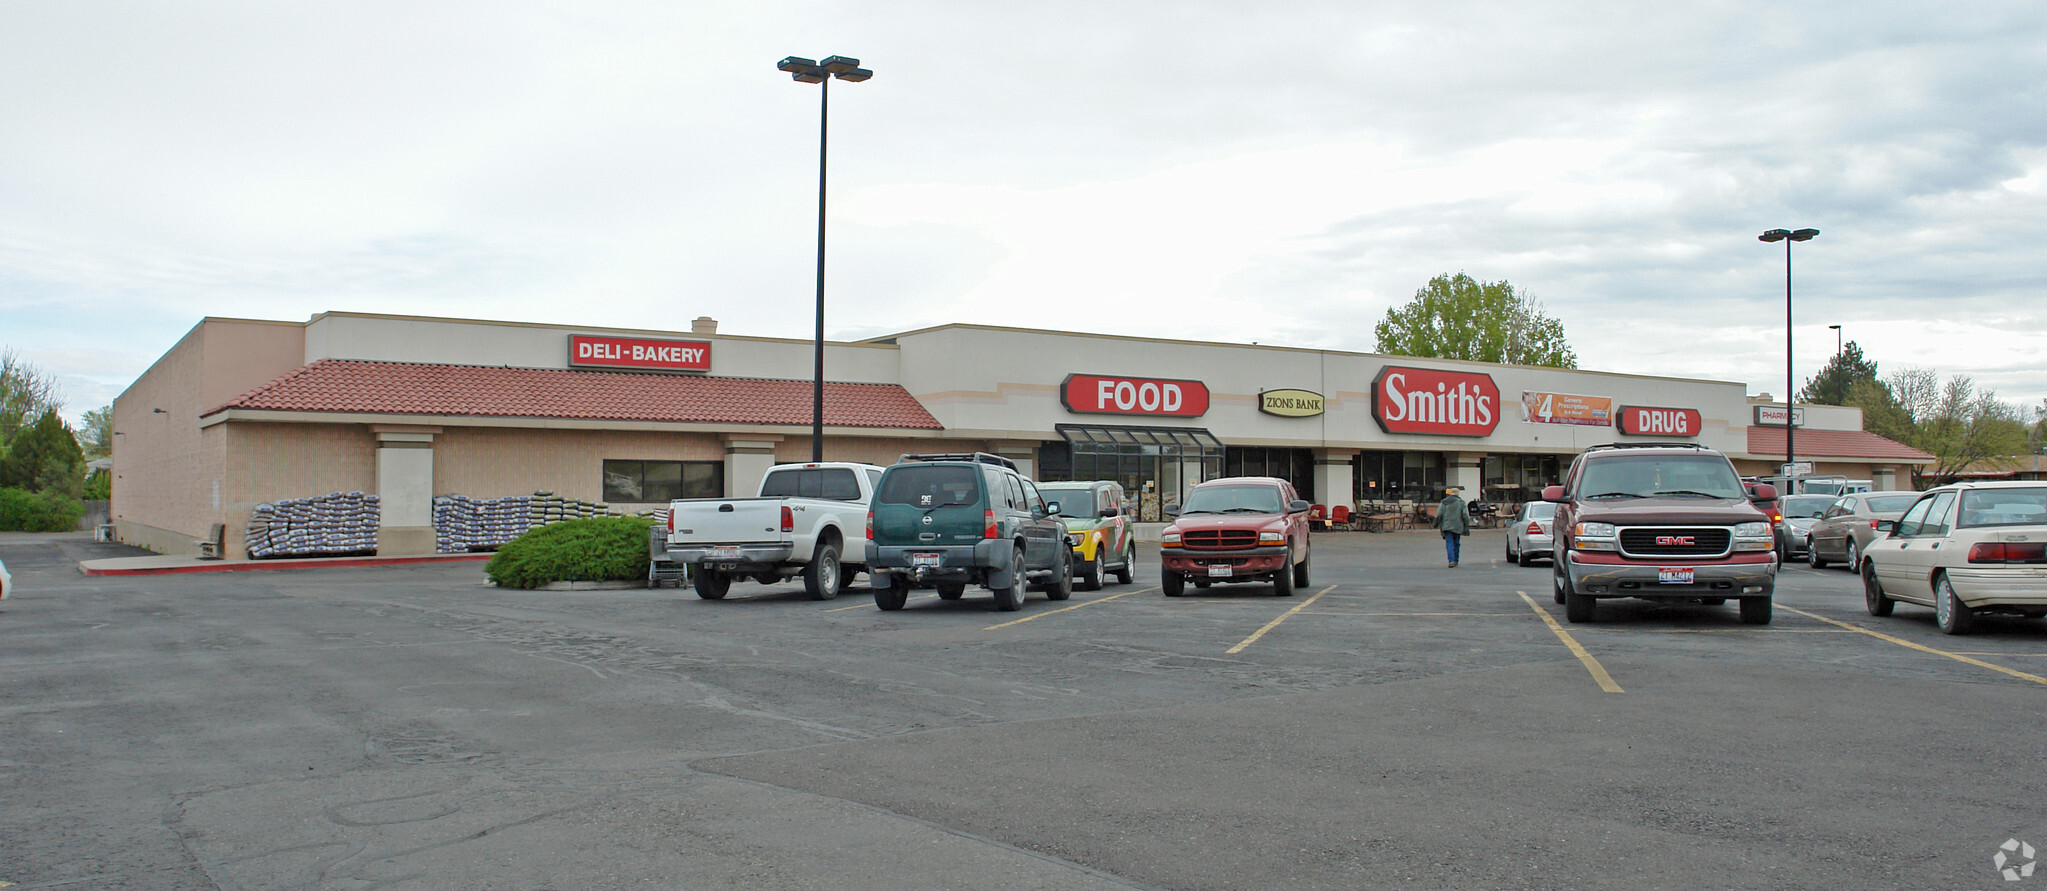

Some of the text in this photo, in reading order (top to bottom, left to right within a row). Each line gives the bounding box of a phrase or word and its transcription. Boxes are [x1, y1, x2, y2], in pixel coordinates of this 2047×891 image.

[579, 343, 704, 363] DELI-BAKERY
[1098, 381, 1182, 412] FOOD
[1266, 397, 1321, 410] ZIONS BANK
[1385, 373, 1491, 426] Smith's
[1639, 410, 1687, 433] DRUG
[1762, 411, 1801, 420] PHARMCY
[1655, 536, 1695, 545] GMC
